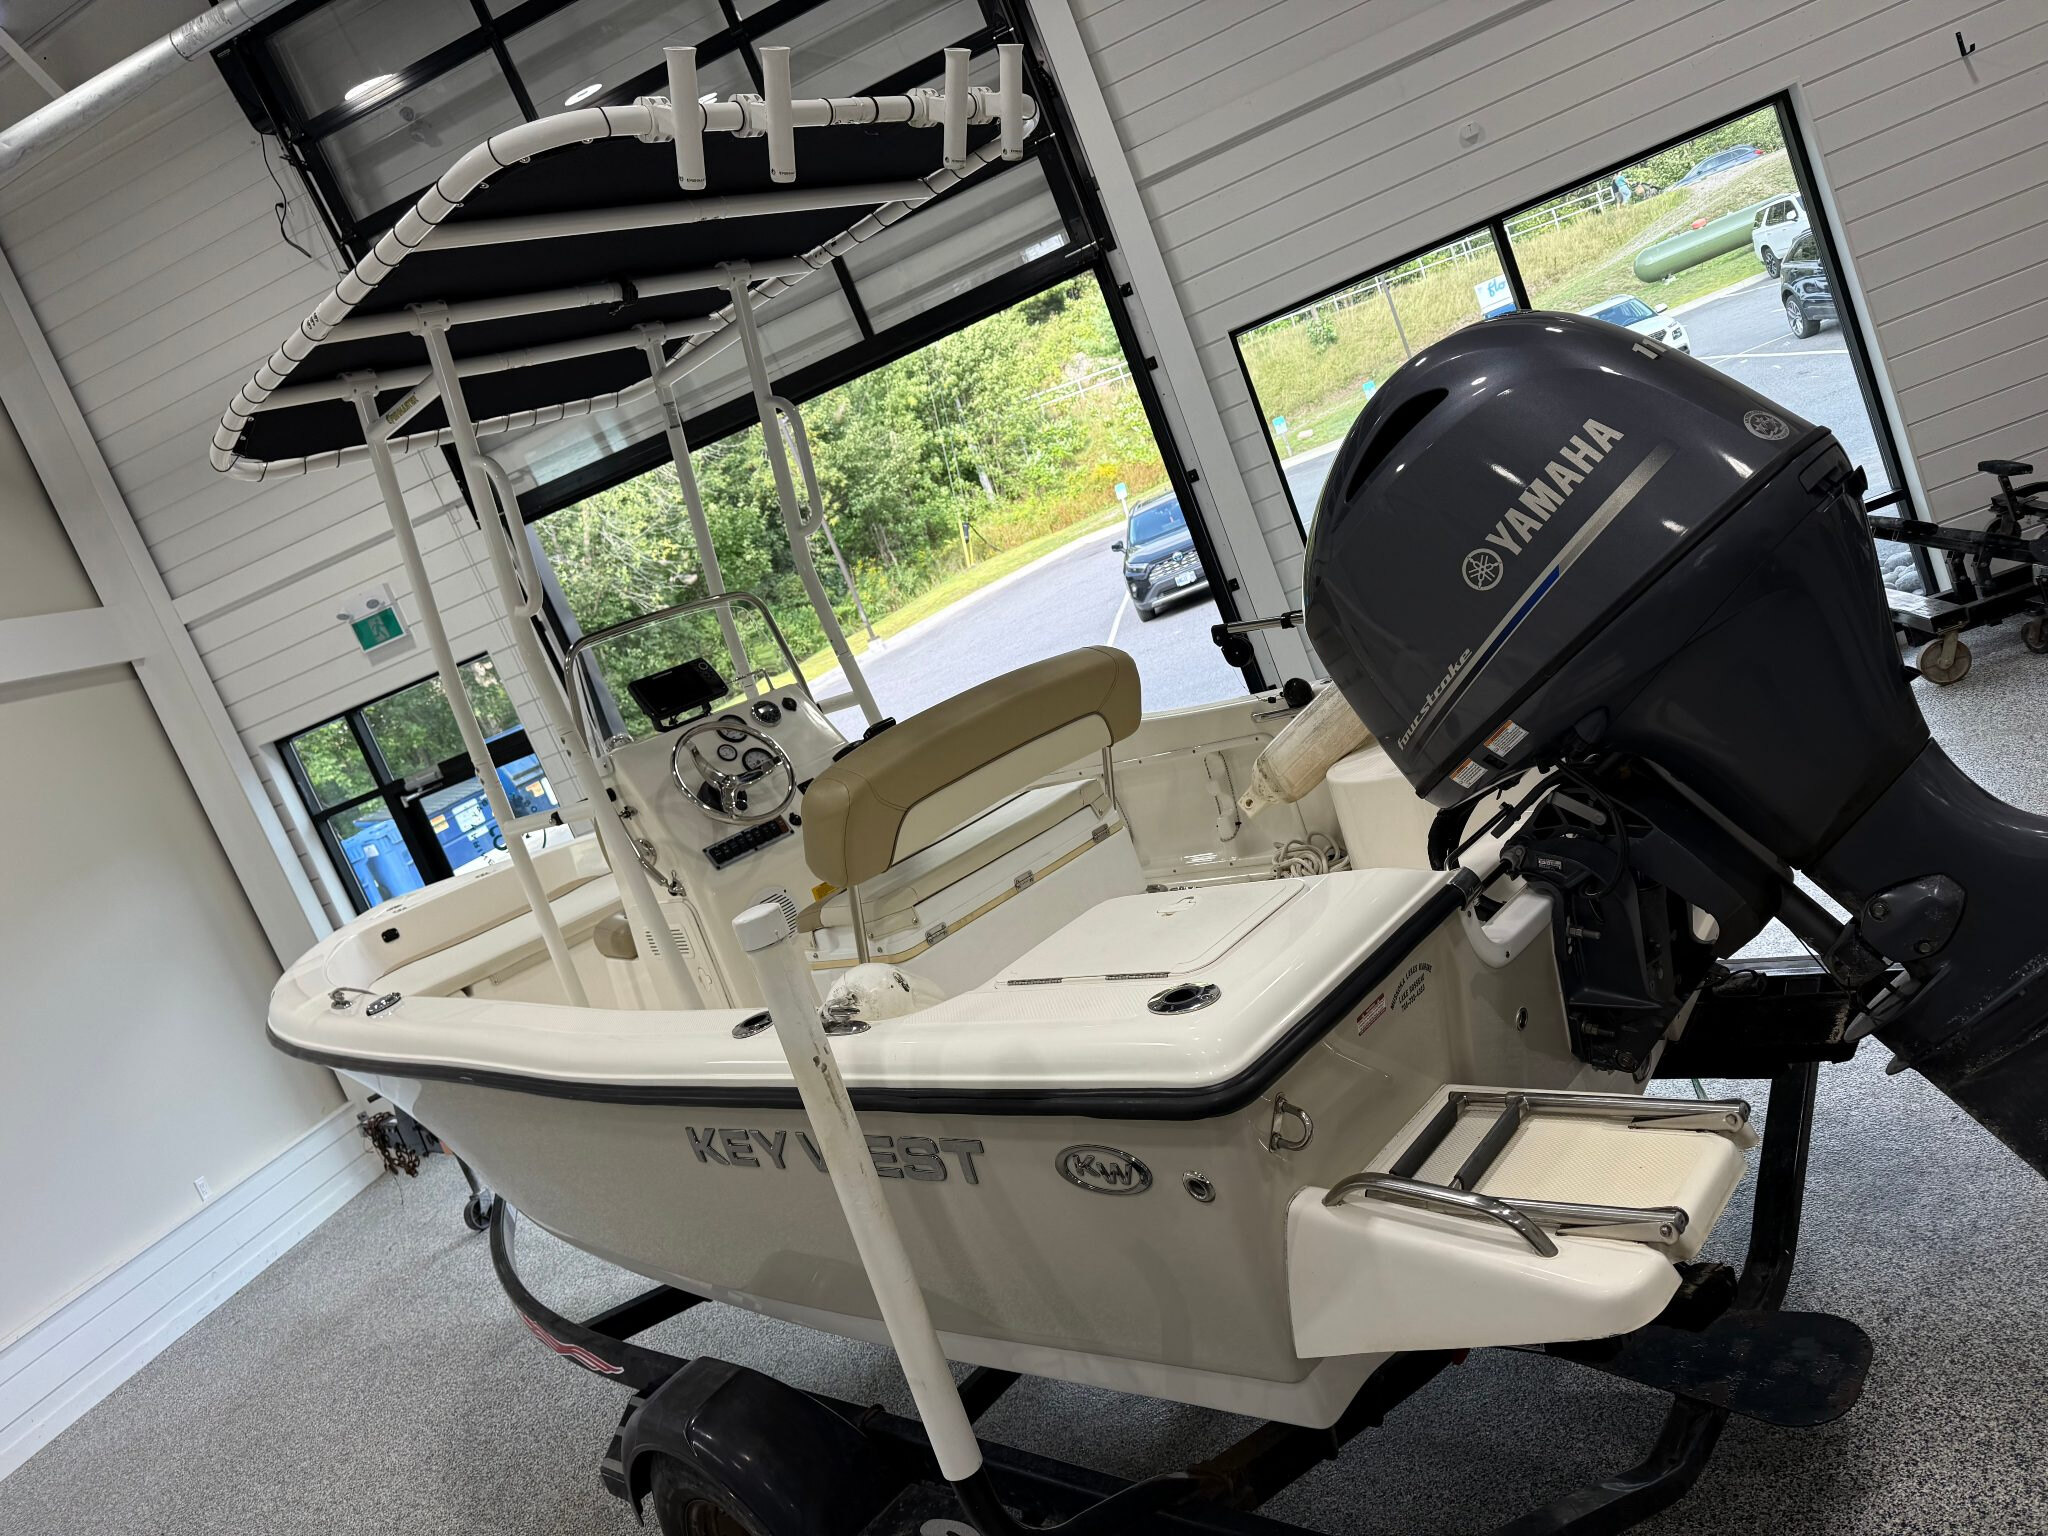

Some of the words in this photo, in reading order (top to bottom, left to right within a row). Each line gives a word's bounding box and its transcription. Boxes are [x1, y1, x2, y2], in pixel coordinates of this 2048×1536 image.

[1484, 417, 1625, 556] YAMAHA
[684, 1126, 787, 1170] KEY
[1073, 1154, 1132, 1185] KW
